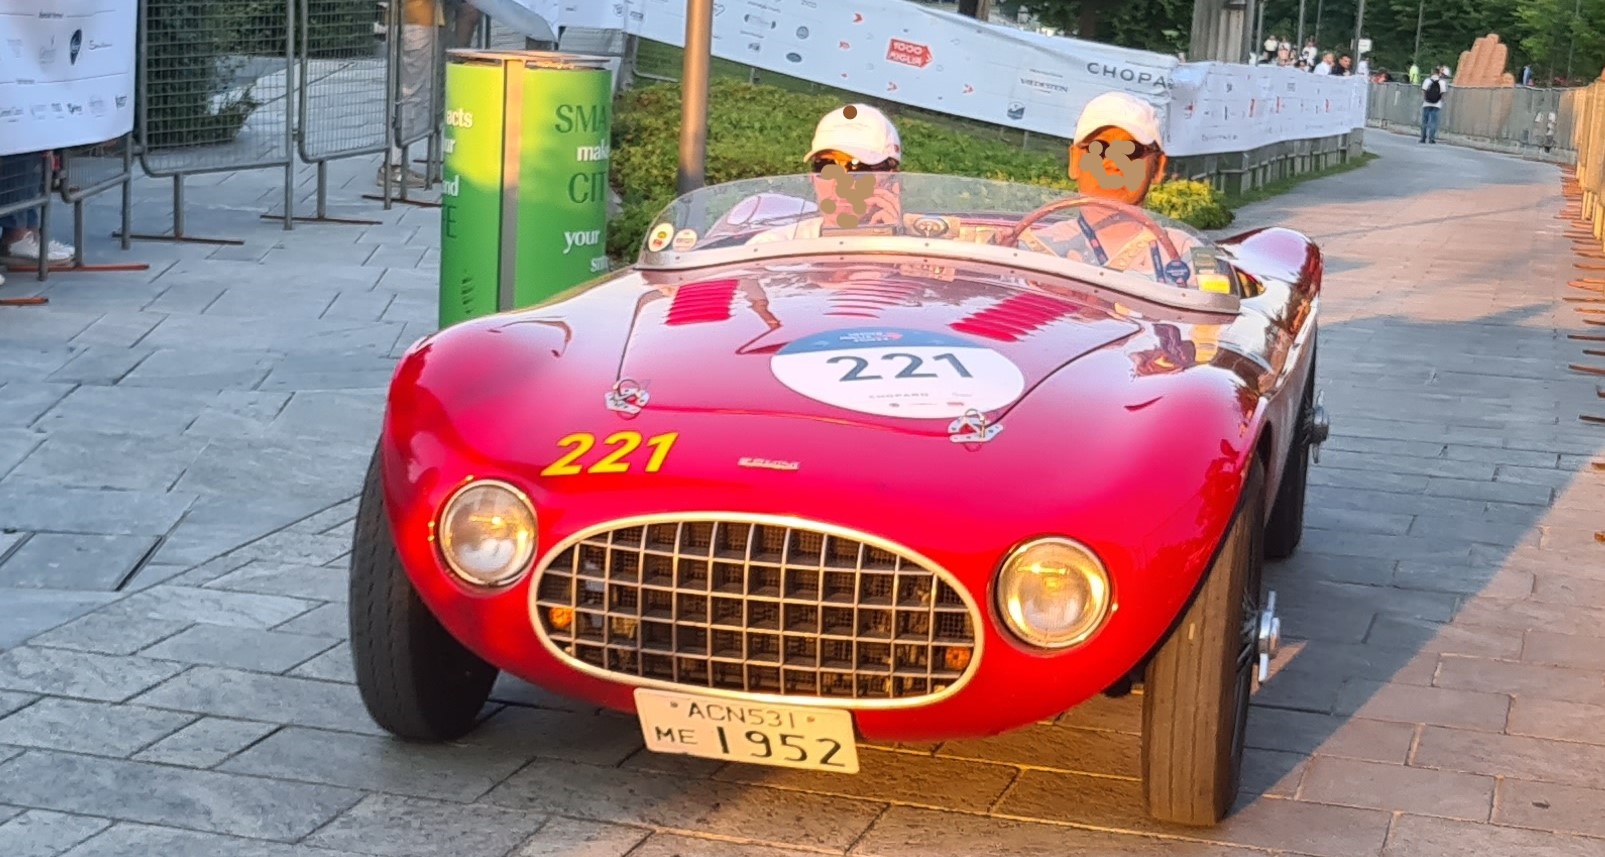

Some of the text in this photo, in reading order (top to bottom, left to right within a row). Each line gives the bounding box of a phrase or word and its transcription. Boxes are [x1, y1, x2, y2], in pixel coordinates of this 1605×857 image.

[893, 41, 923, 56] 1000
[563, 229, 601, 254] your
[826, 353, 973, 382] 221
[540, 430, 679, 477] 221
[688, 702, 795, 729] ACN531
[655, 726, 845, 767] ME 1952
